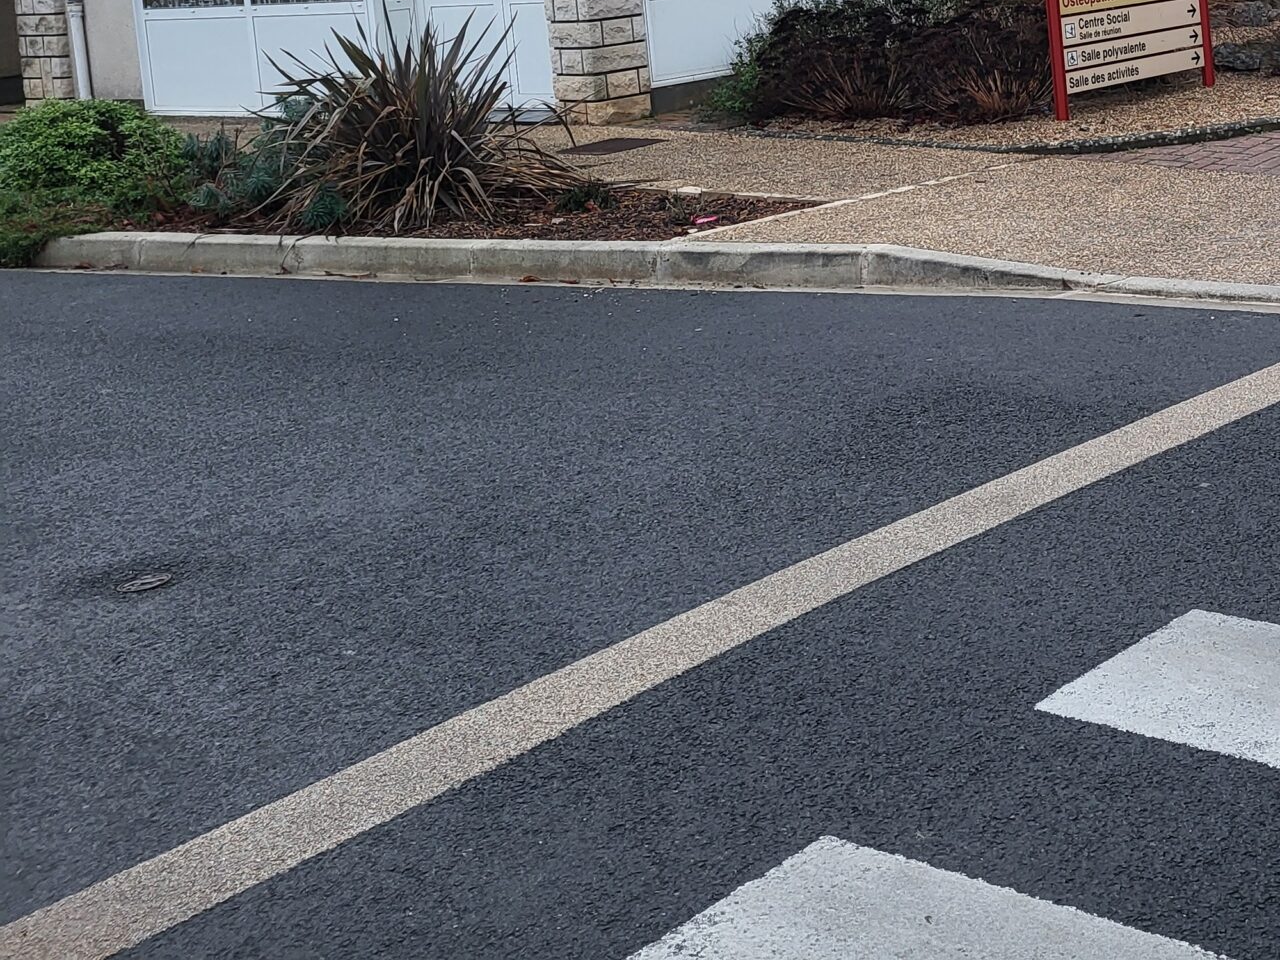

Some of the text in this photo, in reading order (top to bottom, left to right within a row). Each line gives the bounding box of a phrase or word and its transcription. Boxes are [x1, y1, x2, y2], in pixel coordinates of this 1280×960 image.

[1078, 11, 1130, 30] Centre Social
[1079, 27, 1122, 41] Salle de réunion
[1081, 41, 1146, 62] Salle polyvalente
[1069, 64, 1140, 89] Salle des activités
